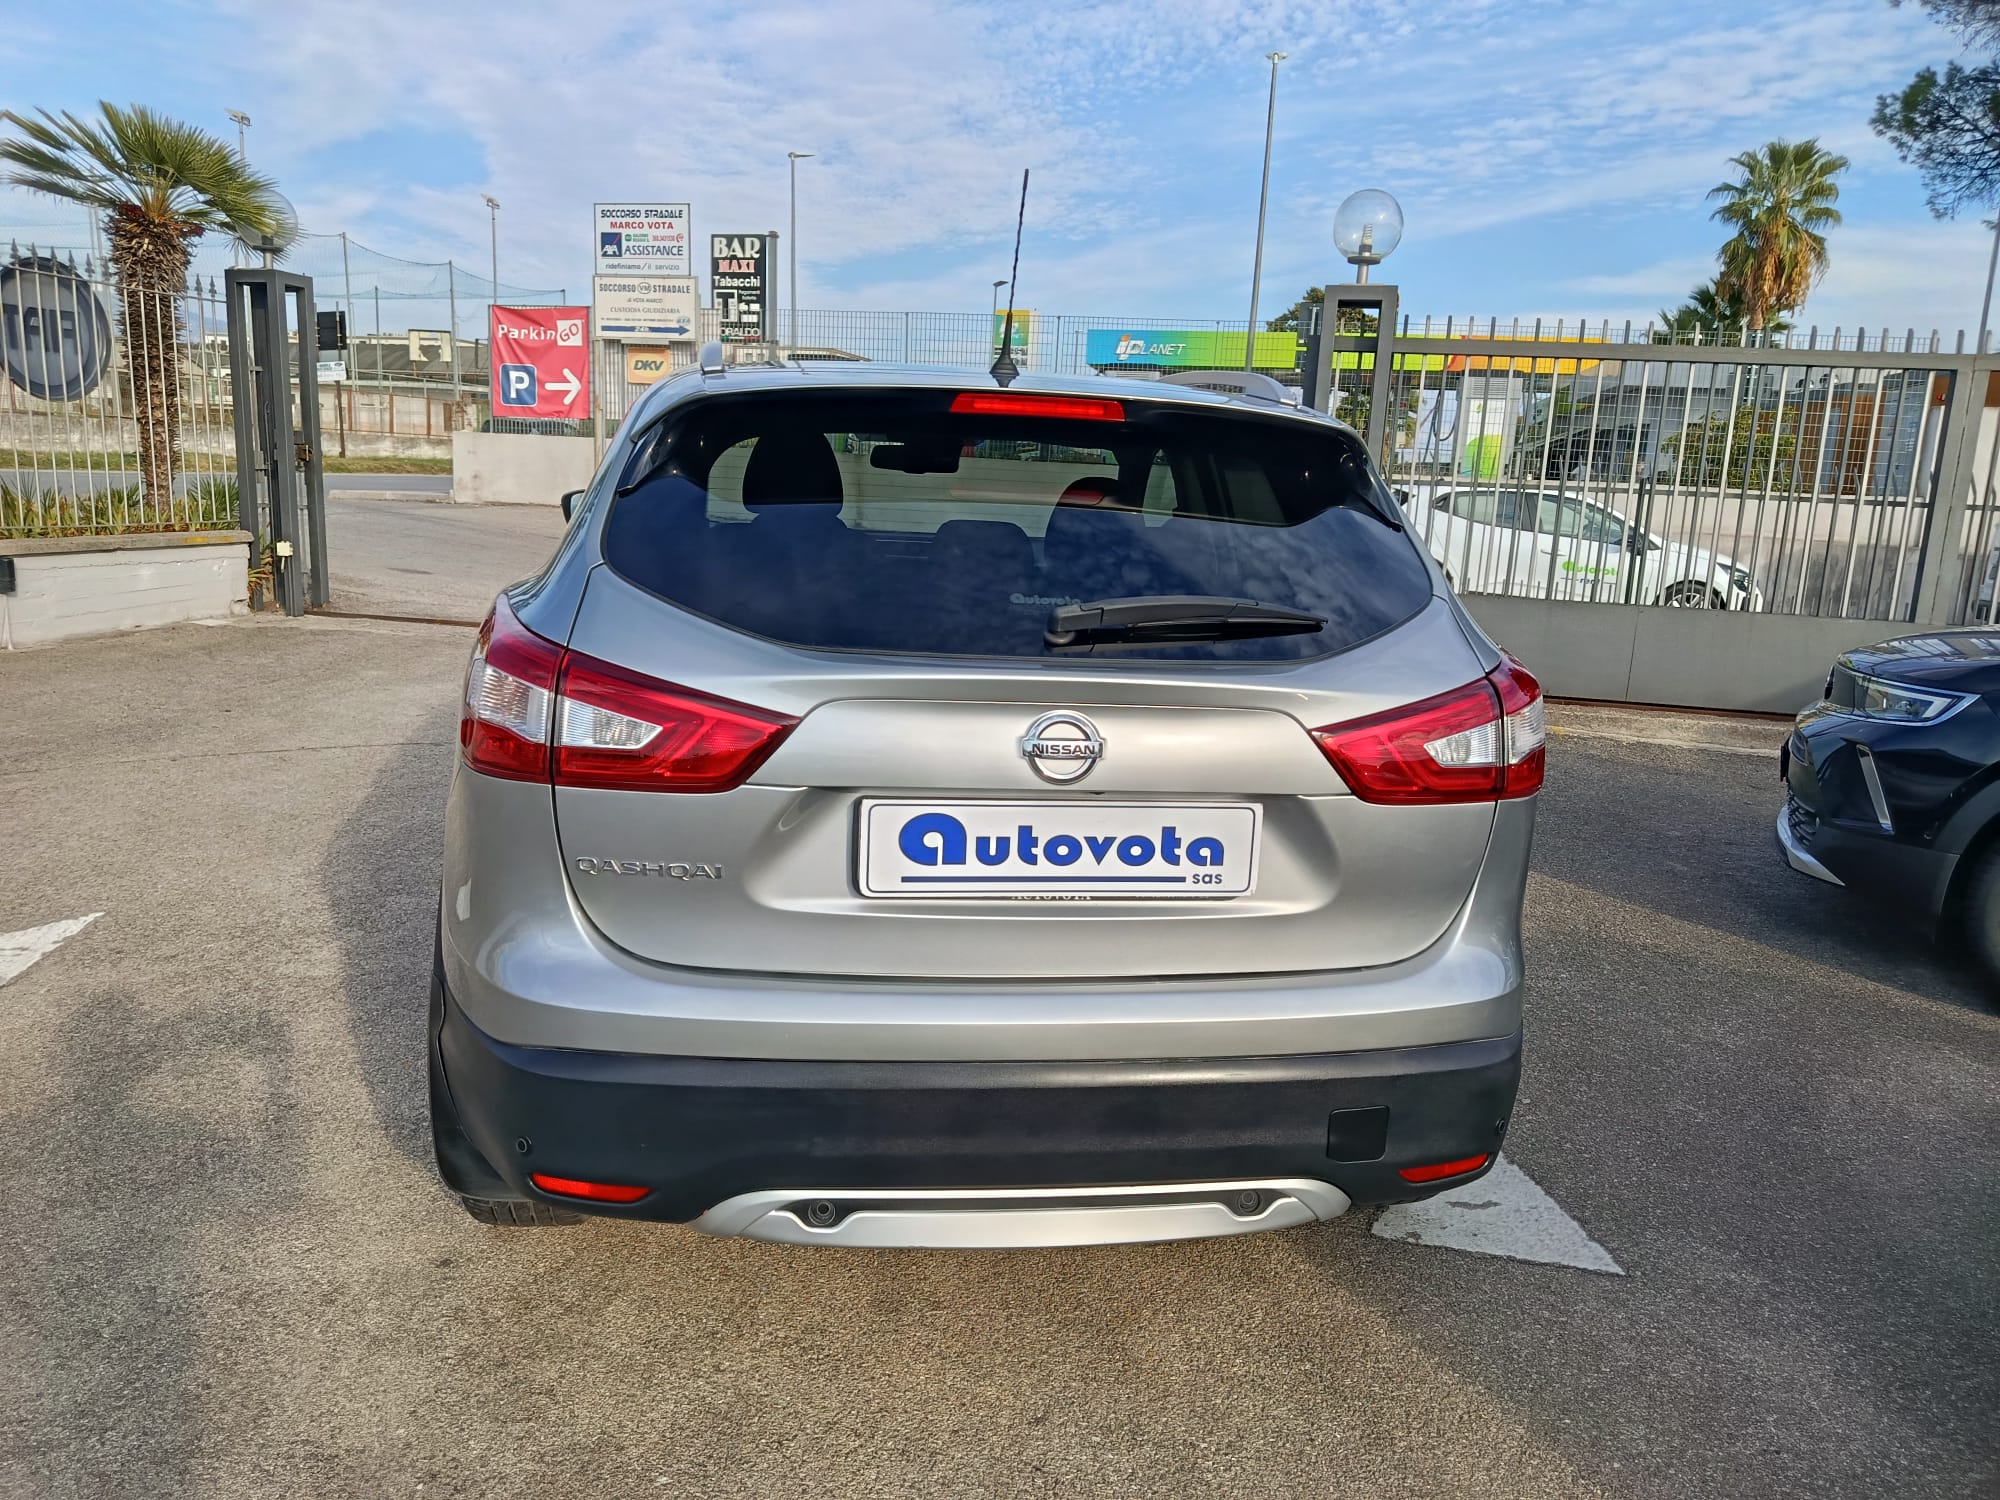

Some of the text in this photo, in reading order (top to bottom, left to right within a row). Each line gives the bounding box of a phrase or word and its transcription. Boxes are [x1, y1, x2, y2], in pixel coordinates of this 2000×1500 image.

[600, 209, 684, 219] SOCCORSO STRADALE
[610, 221, 674, 230] MARCO VOTA
[623, 245, 684, 257] ASSISTANCE
[713, 237, 761, 258] BAR
[655, 263, 680, 271] servizio
[718, 259, 755, 273] MAXI
[713, 275, 761, 287] Tabacchi
[599, 283, 636, 293] SOCCORSO
[652, 284, 691, 294] STRADALE
[609, 306, 641, 314] CUSTODIA
[633, 359, 665, 372] DKV
[508, 370, 530, 399] P
[1031, 742, 1096, 756] NISSAN
[575, 856, 722, 881] QASHQAI
[1191, 873, 1223, 885] sas
